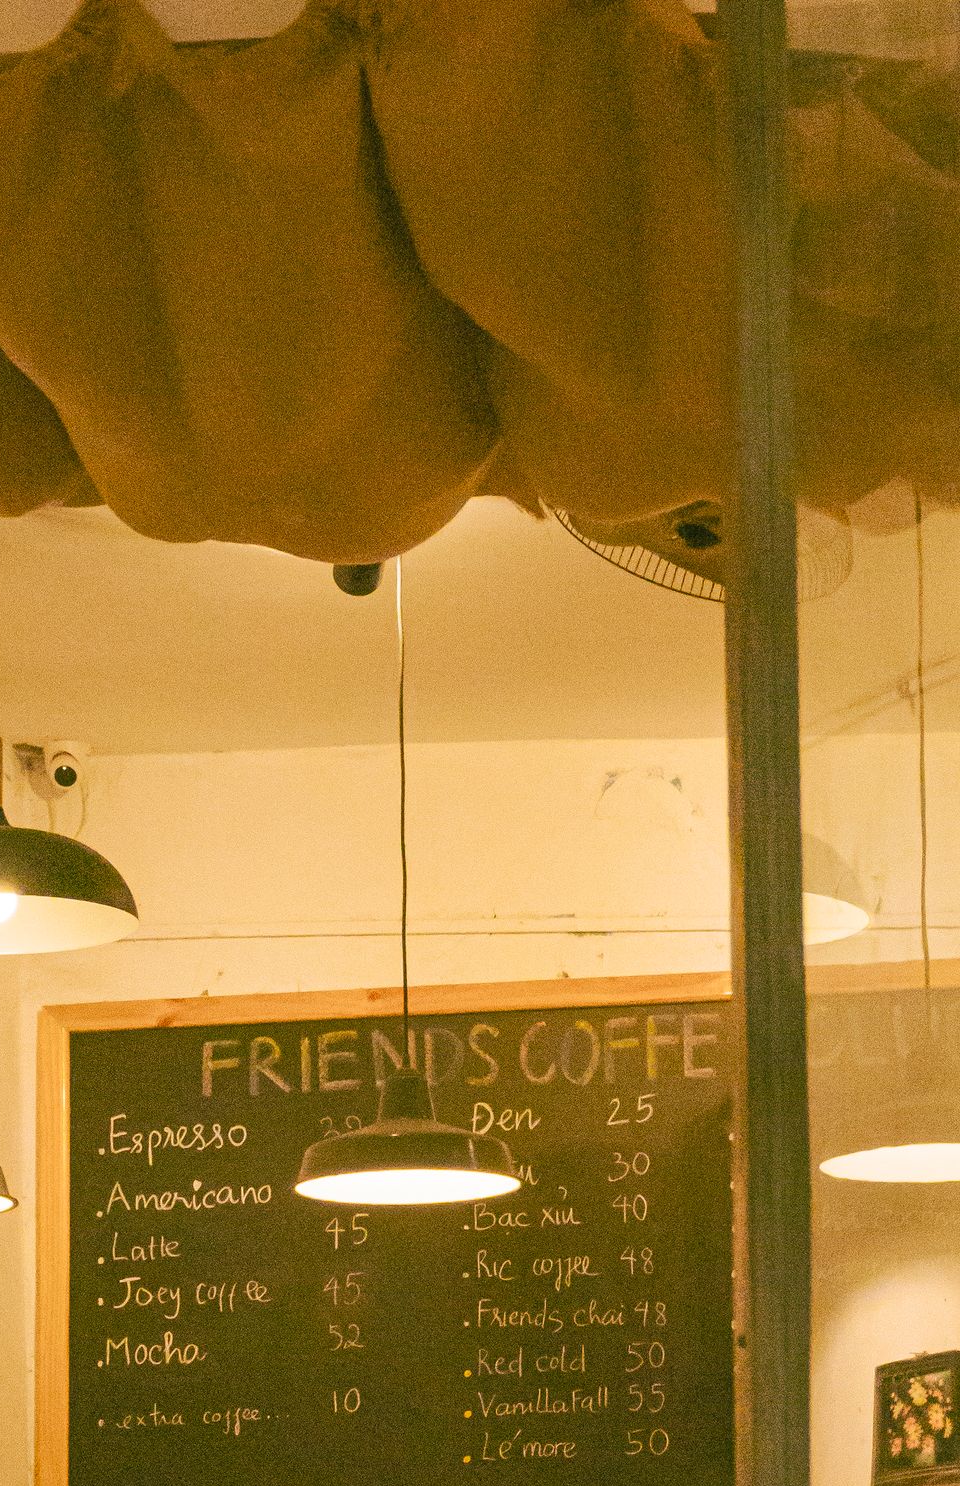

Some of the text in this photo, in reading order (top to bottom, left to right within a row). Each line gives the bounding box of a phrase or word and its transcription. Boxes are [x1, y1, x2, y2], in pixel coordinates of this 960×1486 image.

[201, 1023, 500, 1098] FRIENDS
[519, 1012, 721, 1086] COFFE
[606, 1093, 657, 1127] 25
[108, 1114, 248, 1166] Espresso
[607, 1151, 651, 1183] 30
[106, 1179, 273, 1215] Americano
[612, 1193, 648, 1224] 40
[111, 1213, 371, 1263] Latte 45
[476, 1249, 515, 1282] Ric
[620, 1246, 654, 1275] 48
[113, 1271, 370, 1320] Joey coffee 45
[477, 1298, 668, 1334] Friends chai 48
[105, 1323, 366, 1367] Mocha 52
[477, 1341, 666, 1377] Red cold 50
[115, 1402, 186, 1431] extra
[332, 1386, 362, 1414] 10
[627, 1382, 666, 1414] 55
[624, 1427, 670, 1456] 50
